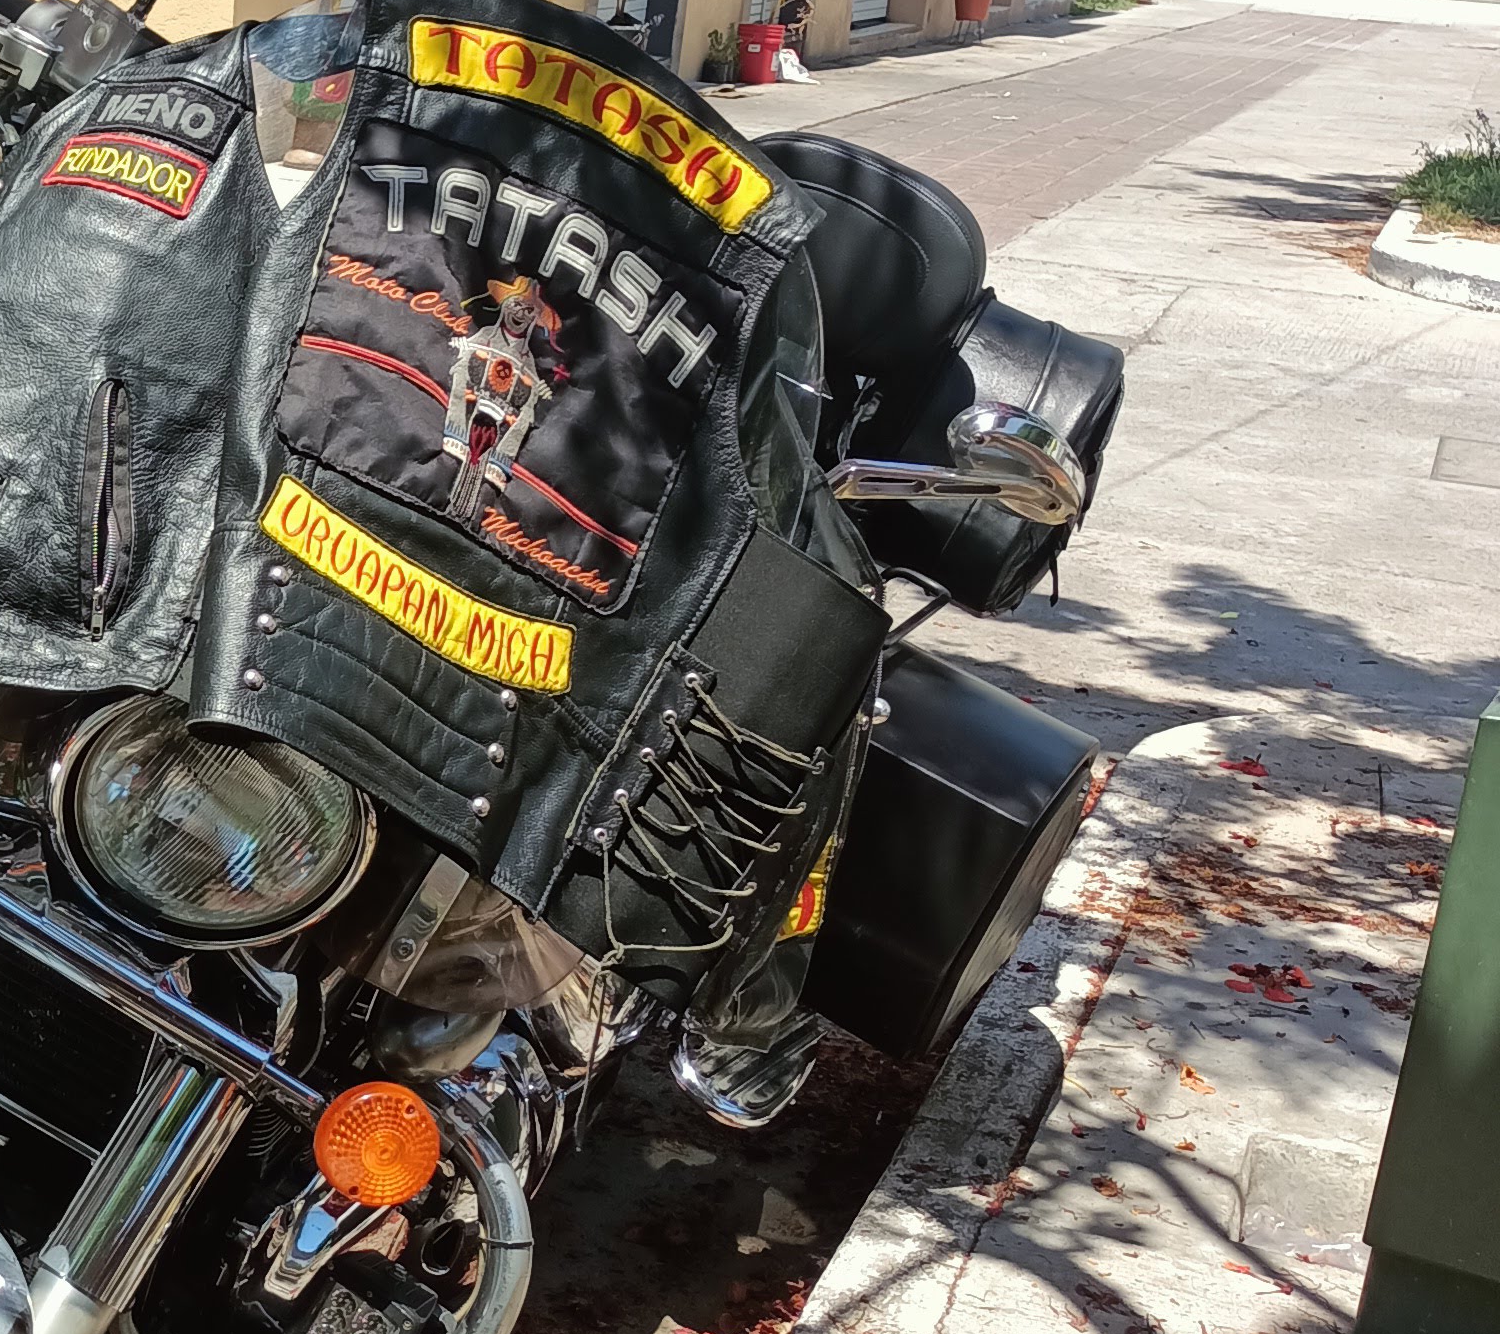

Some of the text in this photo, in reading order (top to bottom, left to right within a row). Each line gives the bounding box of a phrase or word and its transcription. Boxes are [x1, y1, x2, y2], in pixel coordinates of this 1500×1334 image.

[97, 87, 216, 139] MEÑO
[429, 27, 743, 206] TATASH
[57, 147, 193, 204] FUNDADOR
[328, 254, 473, 335] Moto Club
[360, 164, 718, 389] TATASH
[280, 494, 448, 650] URUAPAN
